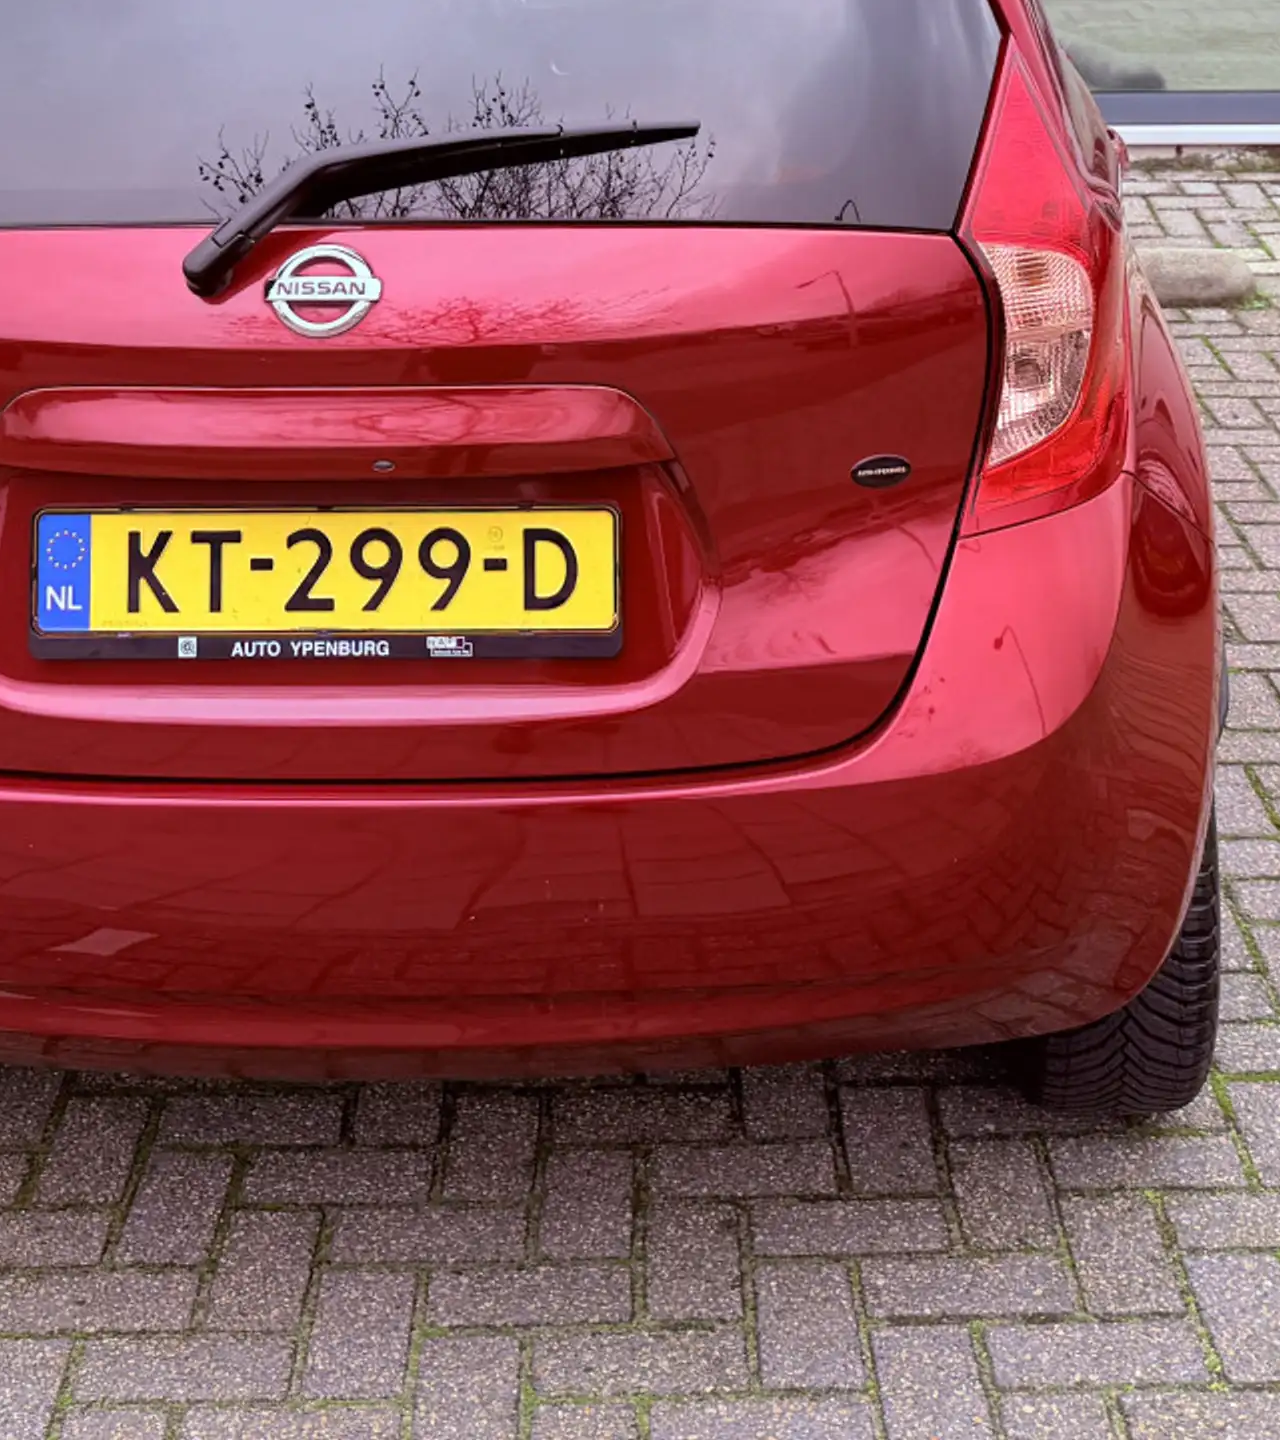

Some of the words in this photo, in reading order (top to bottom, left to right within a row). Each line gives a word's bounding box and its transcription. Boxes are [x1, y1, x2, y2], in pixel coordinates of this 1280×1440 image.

[276, 281, 366, 296] NISSAN
[45, 585, 83, 612] NL
[126, 527, 580, 614] KT-299-D
[230, 640, 282, 658] AUTO
[290, 640, 391, 658] YPENBURG
